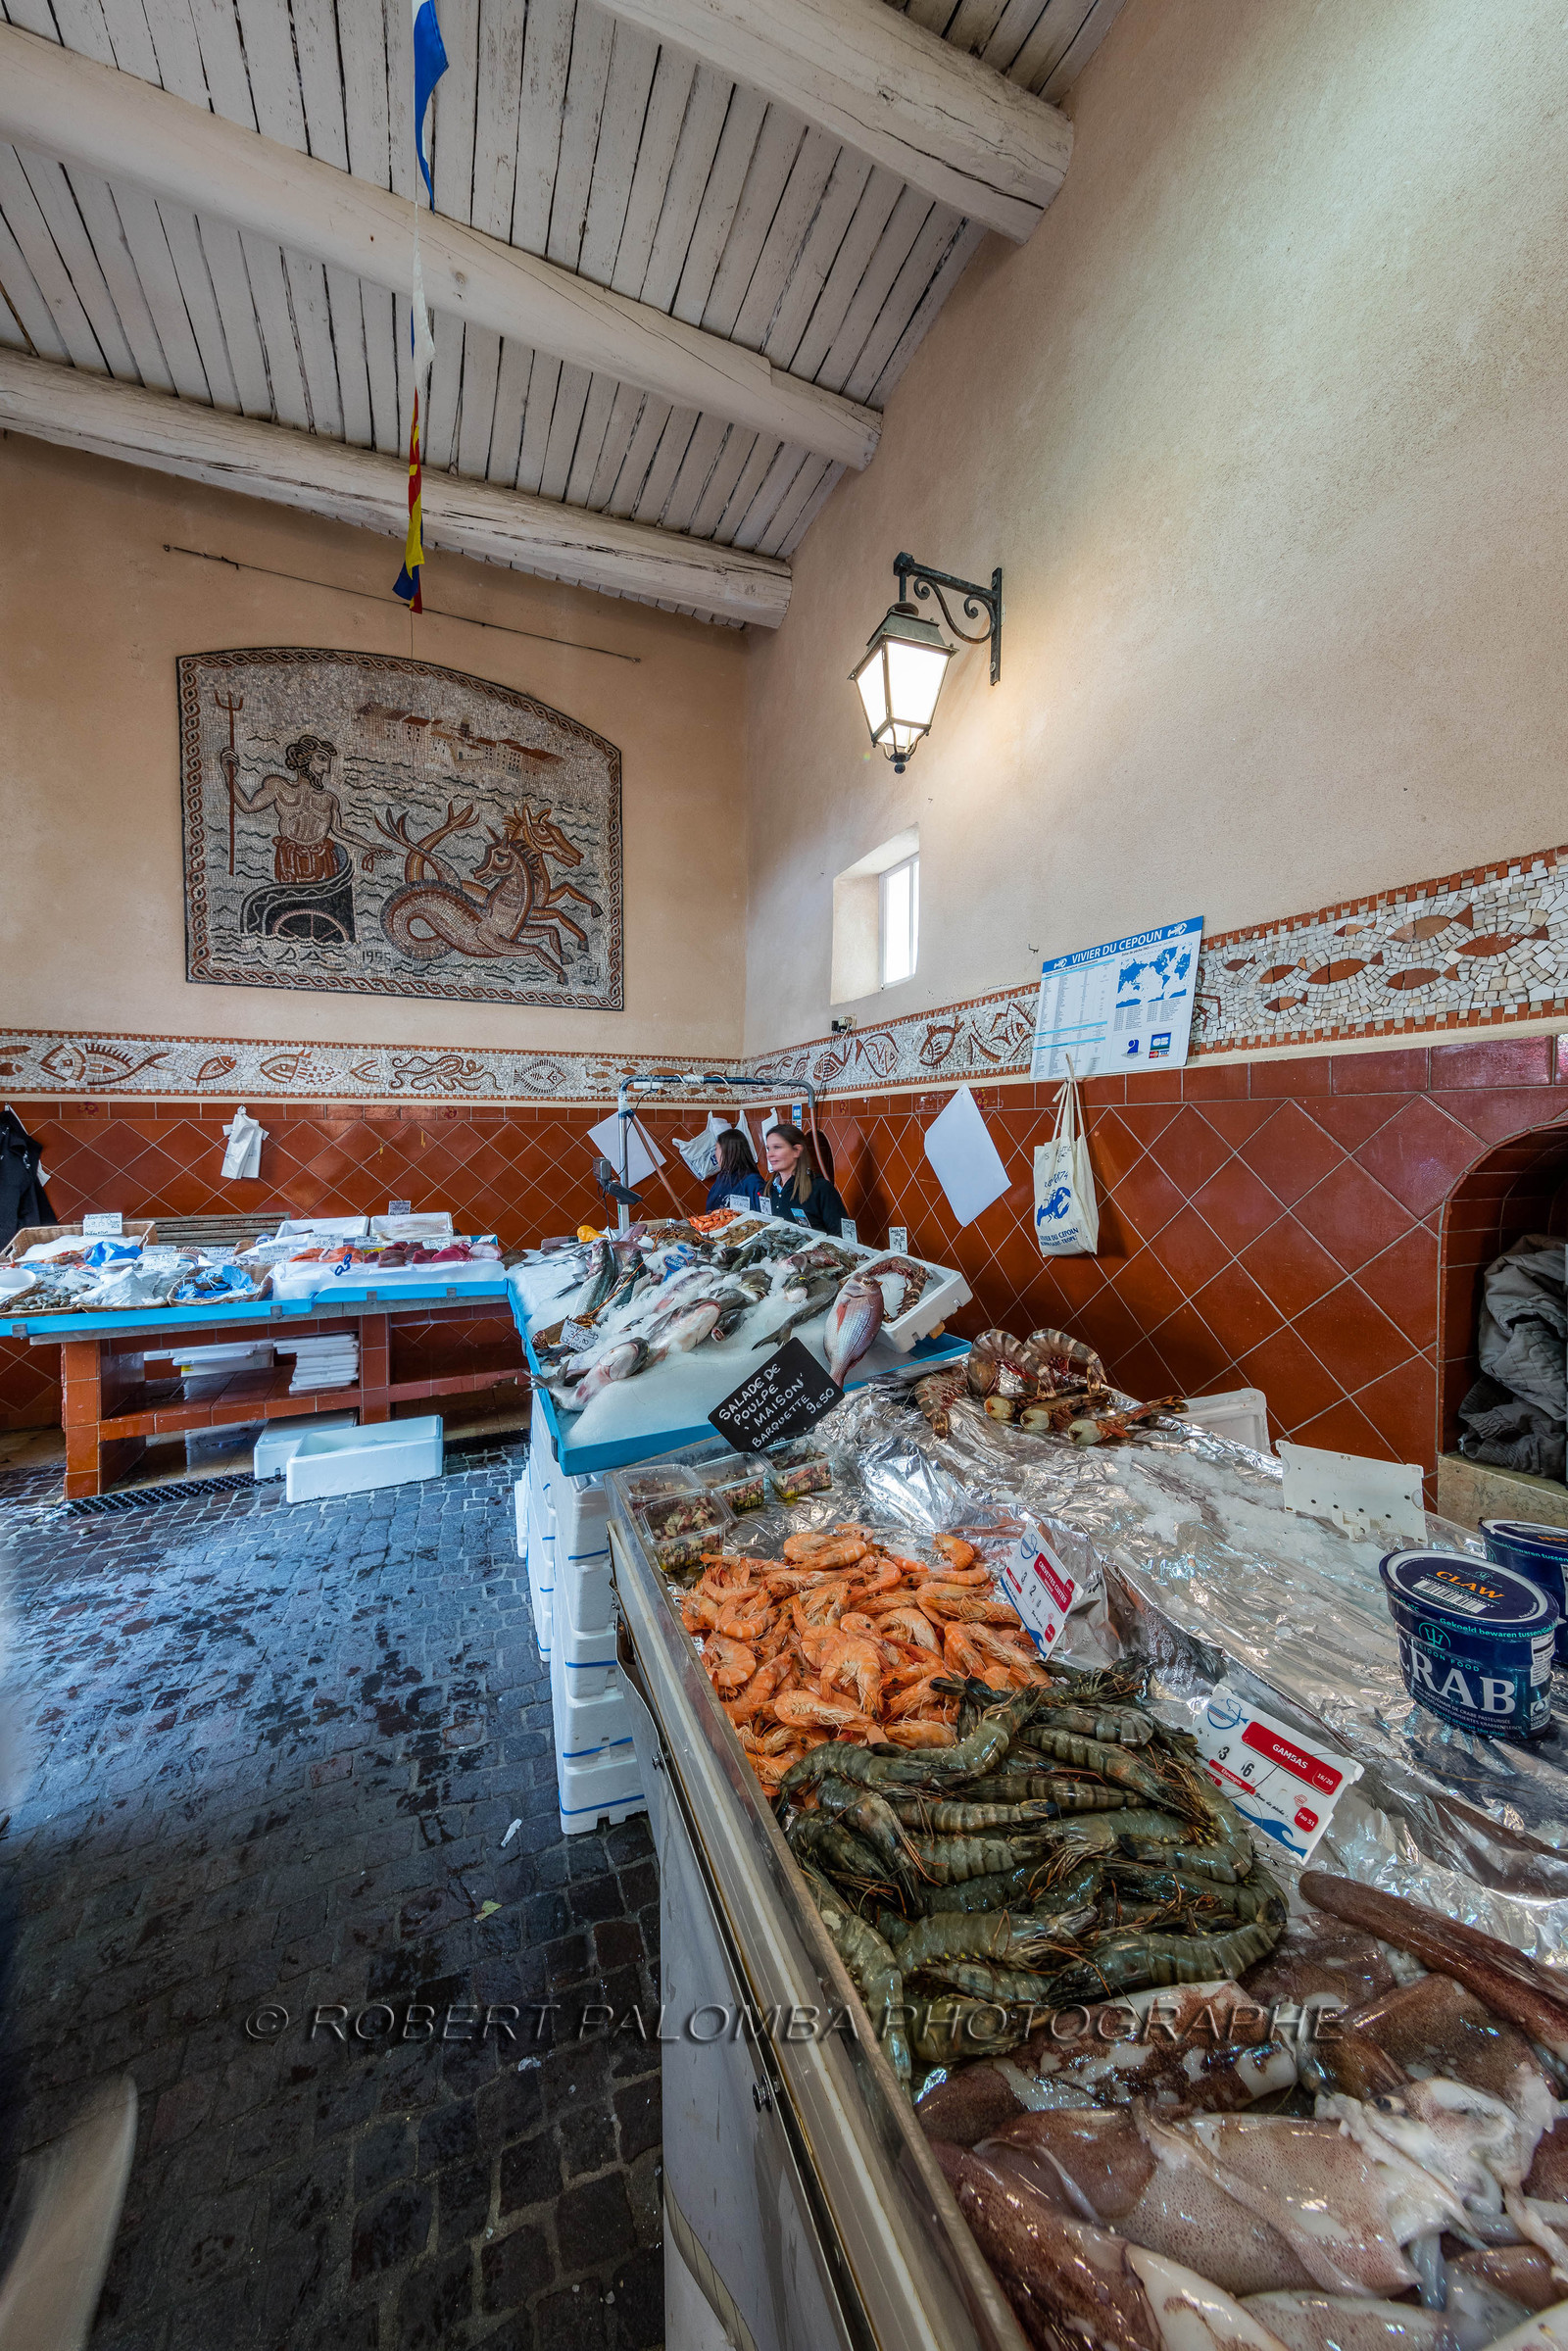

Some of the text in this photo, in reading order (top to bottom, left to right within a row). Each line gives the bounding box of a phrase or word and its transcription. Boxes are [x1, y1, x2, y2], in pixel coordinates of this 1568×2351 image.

[1071, 948, 1101, 964] VIVIER
[1102, 942, 1117, 955] DU
[1119, 930, 1163, 952] CEPOUN
[718, 1363, 781, 1421] SALADE DE
[733, 1384, 779, 1426] POULPE
[752, 1394, 810, 1448] BARQUETTE
[1038, 1560, 1067, 1603] CREVETTES CUITES
[1436, 1571, 1505, 1598] CLAW
[1439, 1617, 1478, 1634] Gekoeld
[1479, 1626, 1517, 1639] bewaren
[1397, 1635, 1516, 1715] CRAB
[1450, 1658, 1480, 1672] FOOD
[1477, 1714, 1511, 1725] PASTEURISÉE
[1272, 1743, 1334, 1787] GAMBAS 16/20
[1298, 1811, 1308, 1822] Fao
